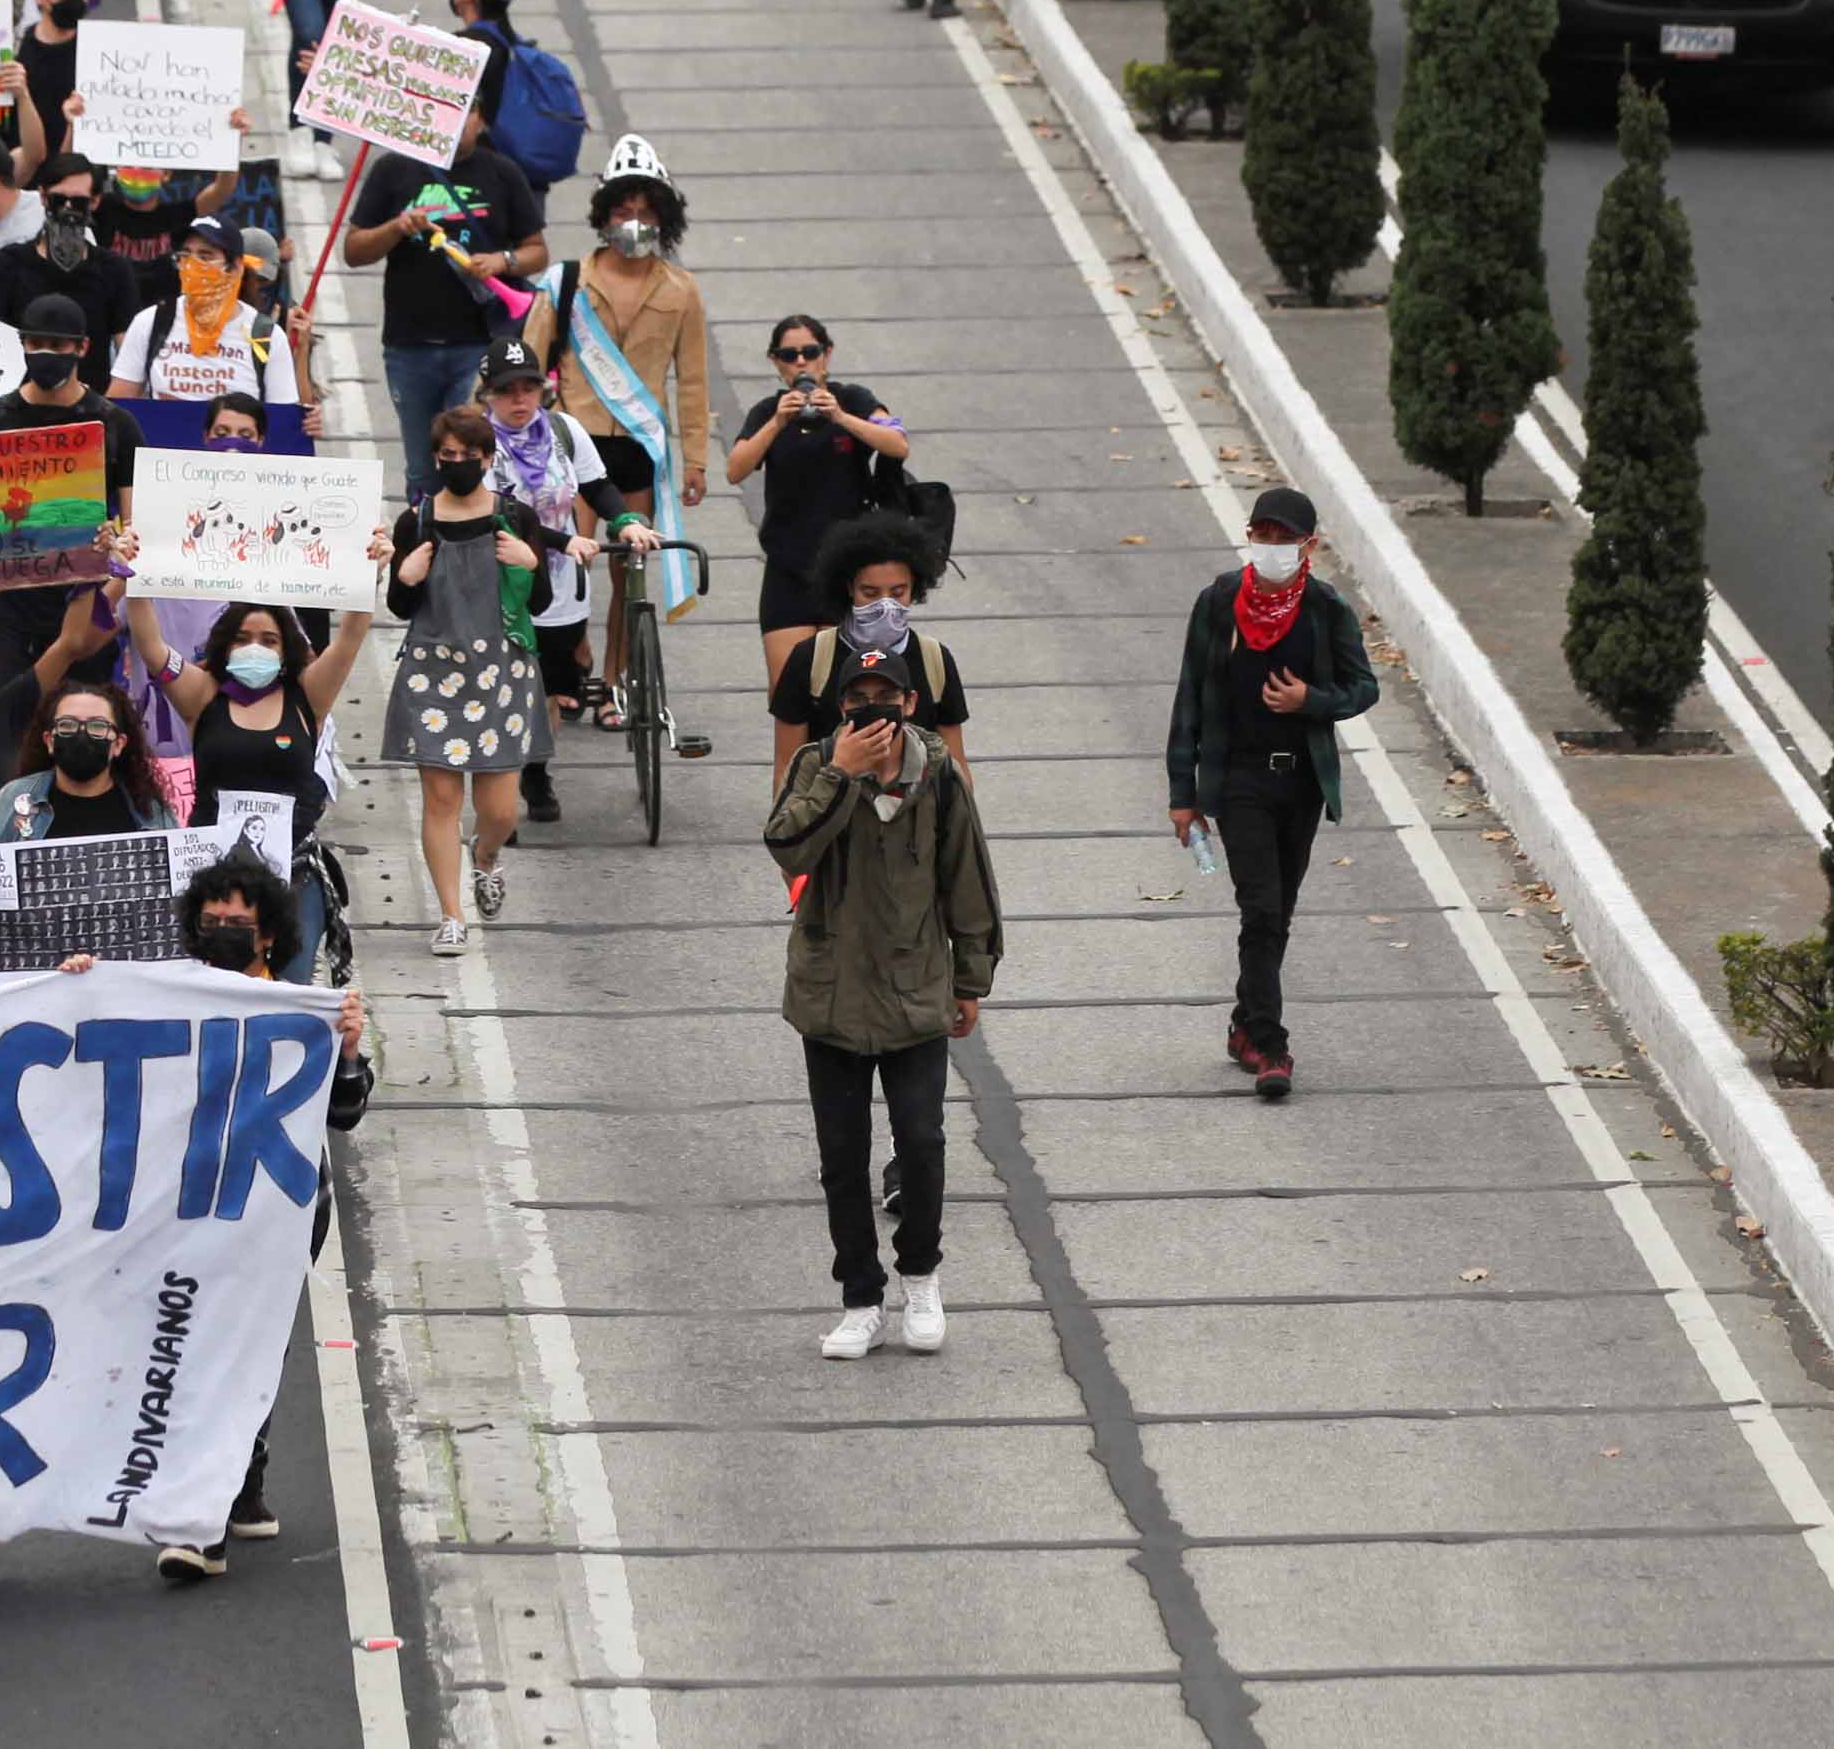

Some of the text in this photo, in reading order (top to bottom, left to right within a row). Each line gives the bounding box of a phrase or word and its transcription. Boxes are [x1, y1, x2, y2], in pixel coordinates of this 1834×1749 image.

[170, 341, 246, 361] Mahan
[162, 363, 237, 381] Instant
[168, 377, 228, 395] Lunch
[154, 459, 171, 483] El
[181, 460, 247, 488] Congreso
[254, 469, 297, 486] viendo
[255, 578, 270, 594] de
[87, 1268, 200, 1529] LANDIVARIANOS
